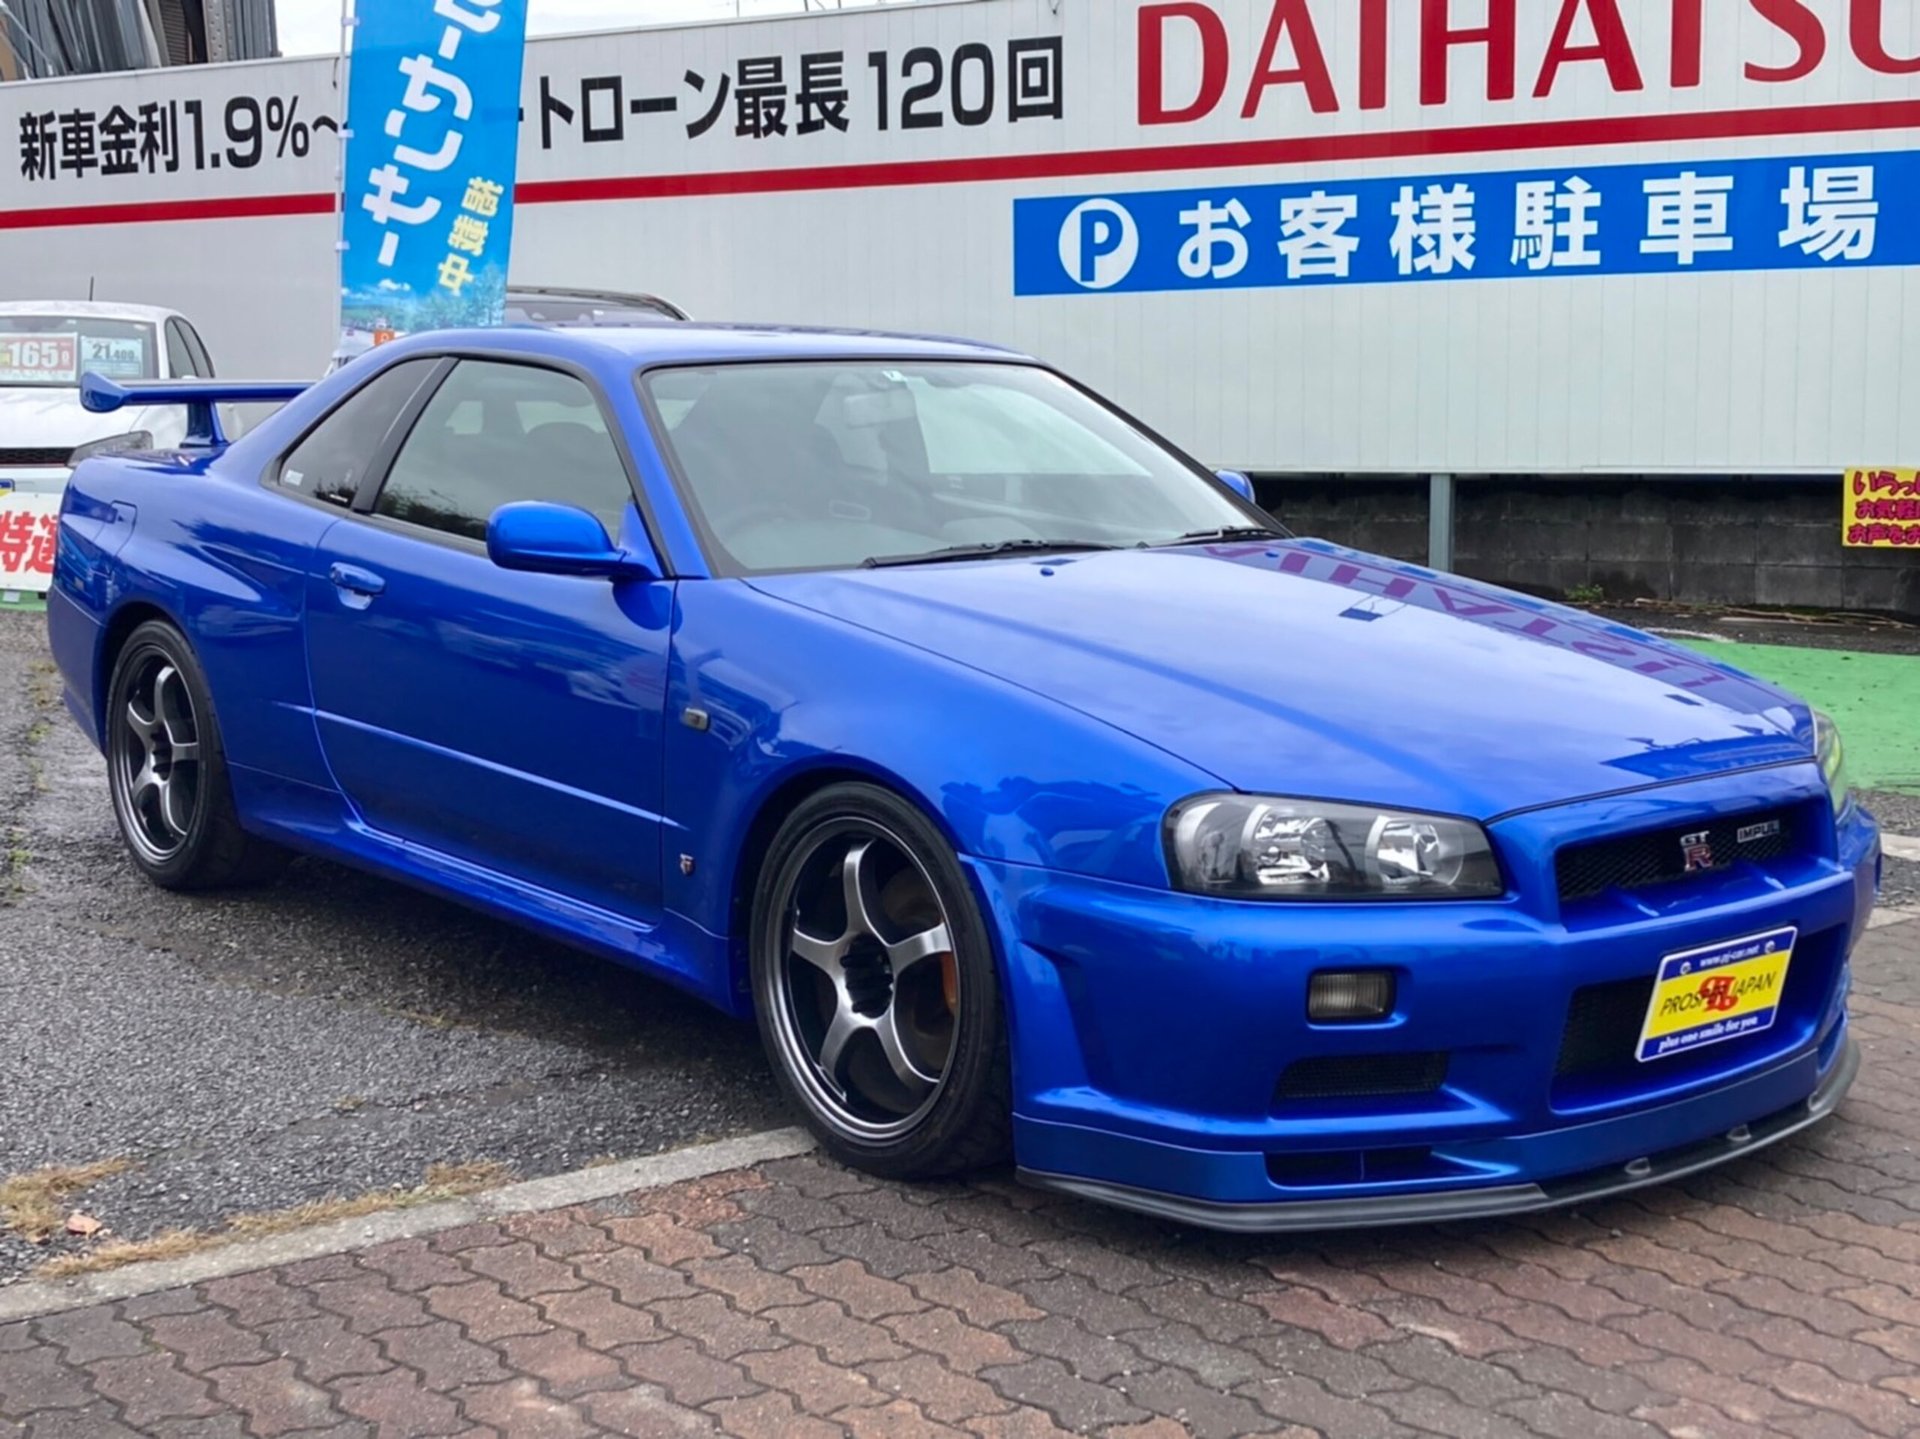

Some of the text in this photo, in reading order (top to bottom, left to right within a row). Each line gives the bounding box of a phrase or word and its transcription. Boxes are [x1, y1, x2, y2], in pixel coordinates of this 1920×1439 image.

[518, 36, 1063, 149] トローン最長120回
[1176, 165, 1880, 280] お客様駐車場
